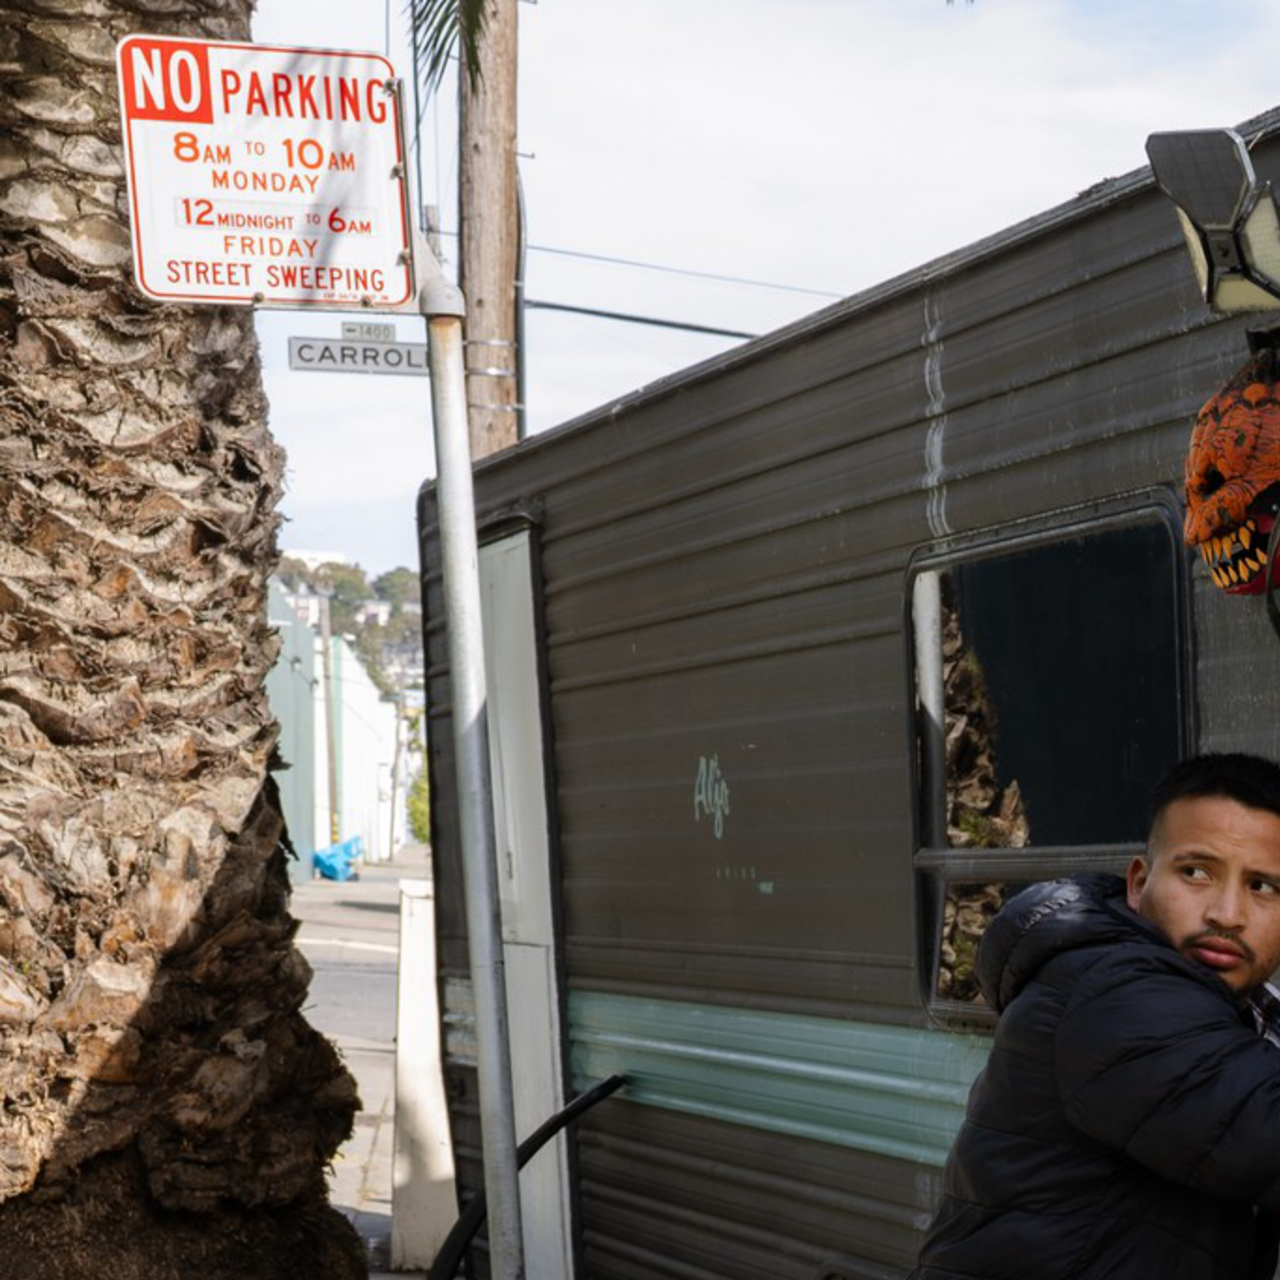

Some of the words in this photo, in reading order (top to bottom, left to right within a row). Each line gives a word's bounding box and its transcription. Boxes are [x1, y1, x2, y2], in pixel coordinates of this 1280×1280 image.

[131, 46, 202, 114] NO
[221, 69, 387, 124] PARKING
[245, 141, 265, 156] TO
[212, 170, 320, 194] MONDAY
[305, 213, 321, 226] TO
[223, 235, 319, 259] FRIDAY
[166, 259, 253, 287] STREET
[267, 264, 385, 293] SWEEPING
[359, 324, 391, 339] 1400
[297, 344, 428, 370] CARROL
